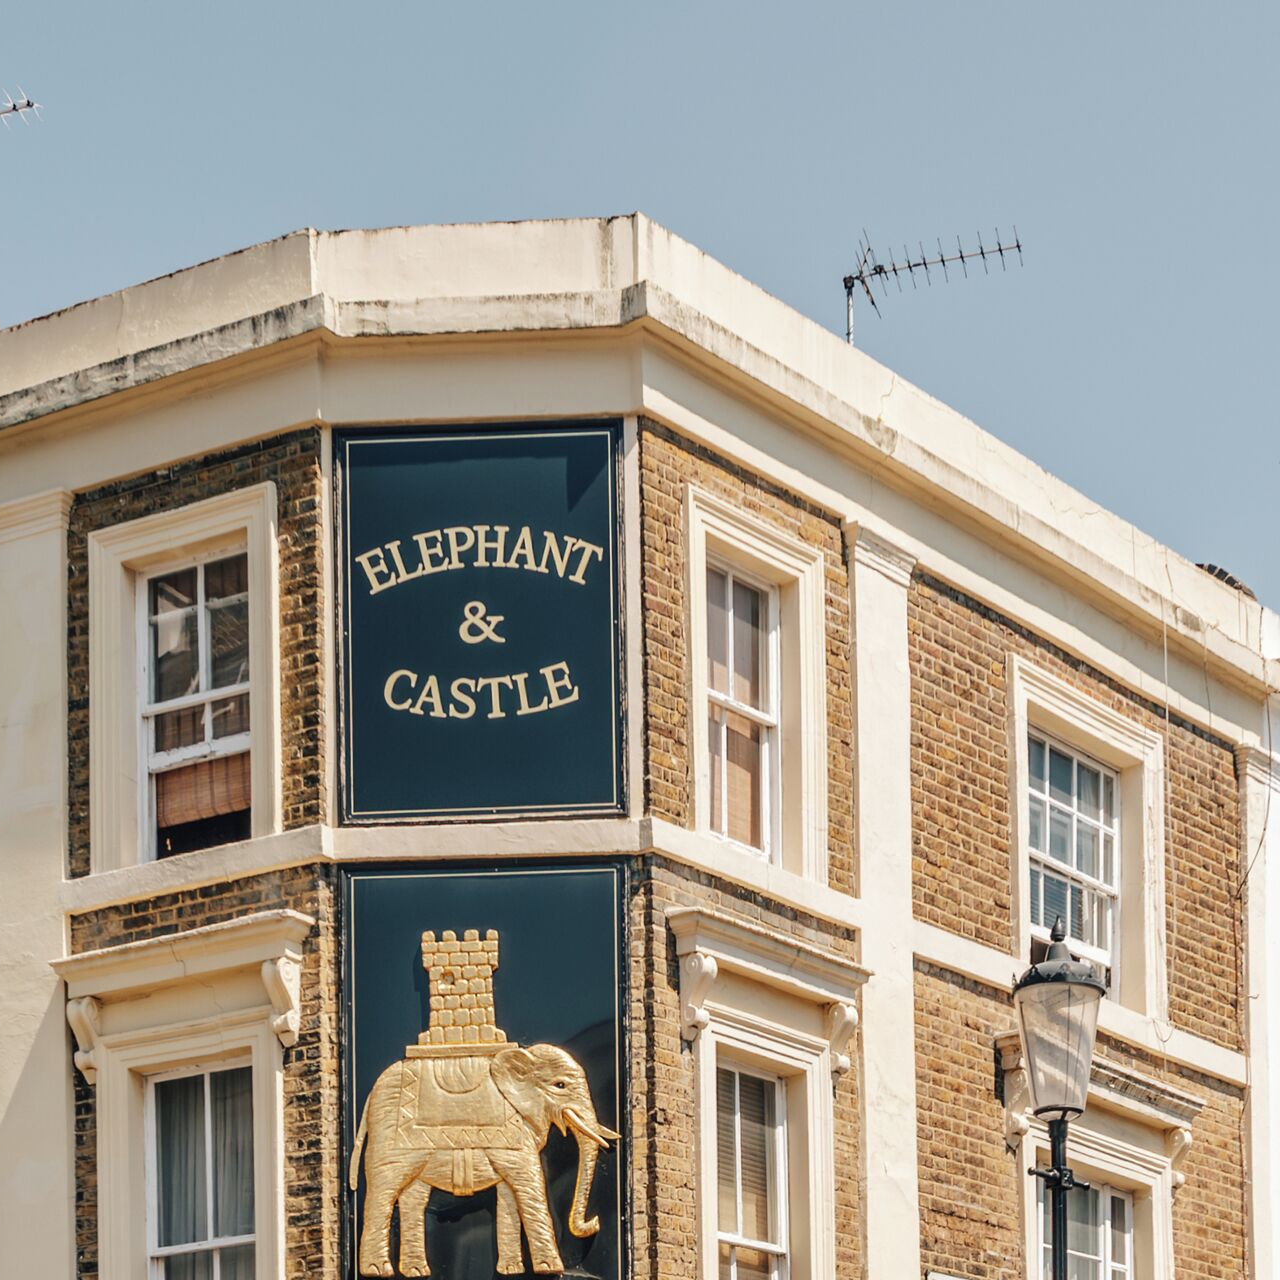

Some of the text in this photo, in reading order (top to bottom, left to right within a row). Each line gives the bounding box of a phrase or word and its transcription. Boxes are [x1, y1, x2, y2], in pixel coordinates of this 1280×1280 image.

[355, 525, 604, 595] ELEPHANT
[458, 601, 506, 644] &
[383, 661, 579, 719] CASTLE
